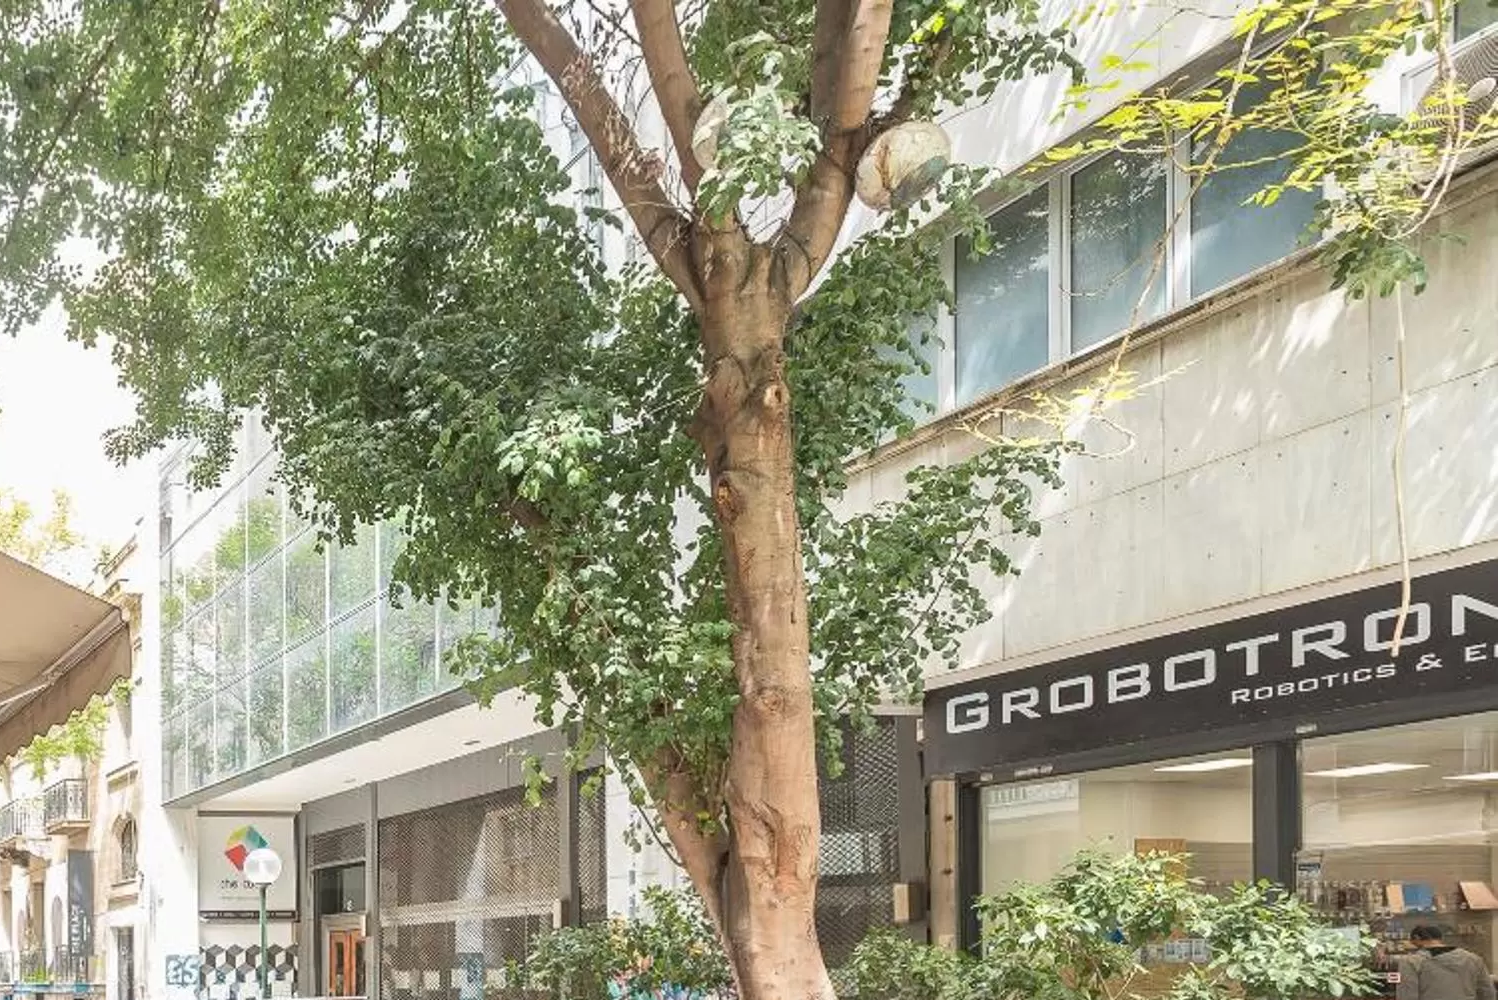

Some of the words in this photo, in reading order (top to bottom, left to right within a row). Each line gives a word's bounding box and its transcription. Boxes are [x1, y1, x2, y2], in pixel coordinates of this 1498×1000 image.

[1230, 662, 1397, 705] ROBOTICS
[1415, 652, 1444, 672] &
[1464, 642, 1498, 663] E
